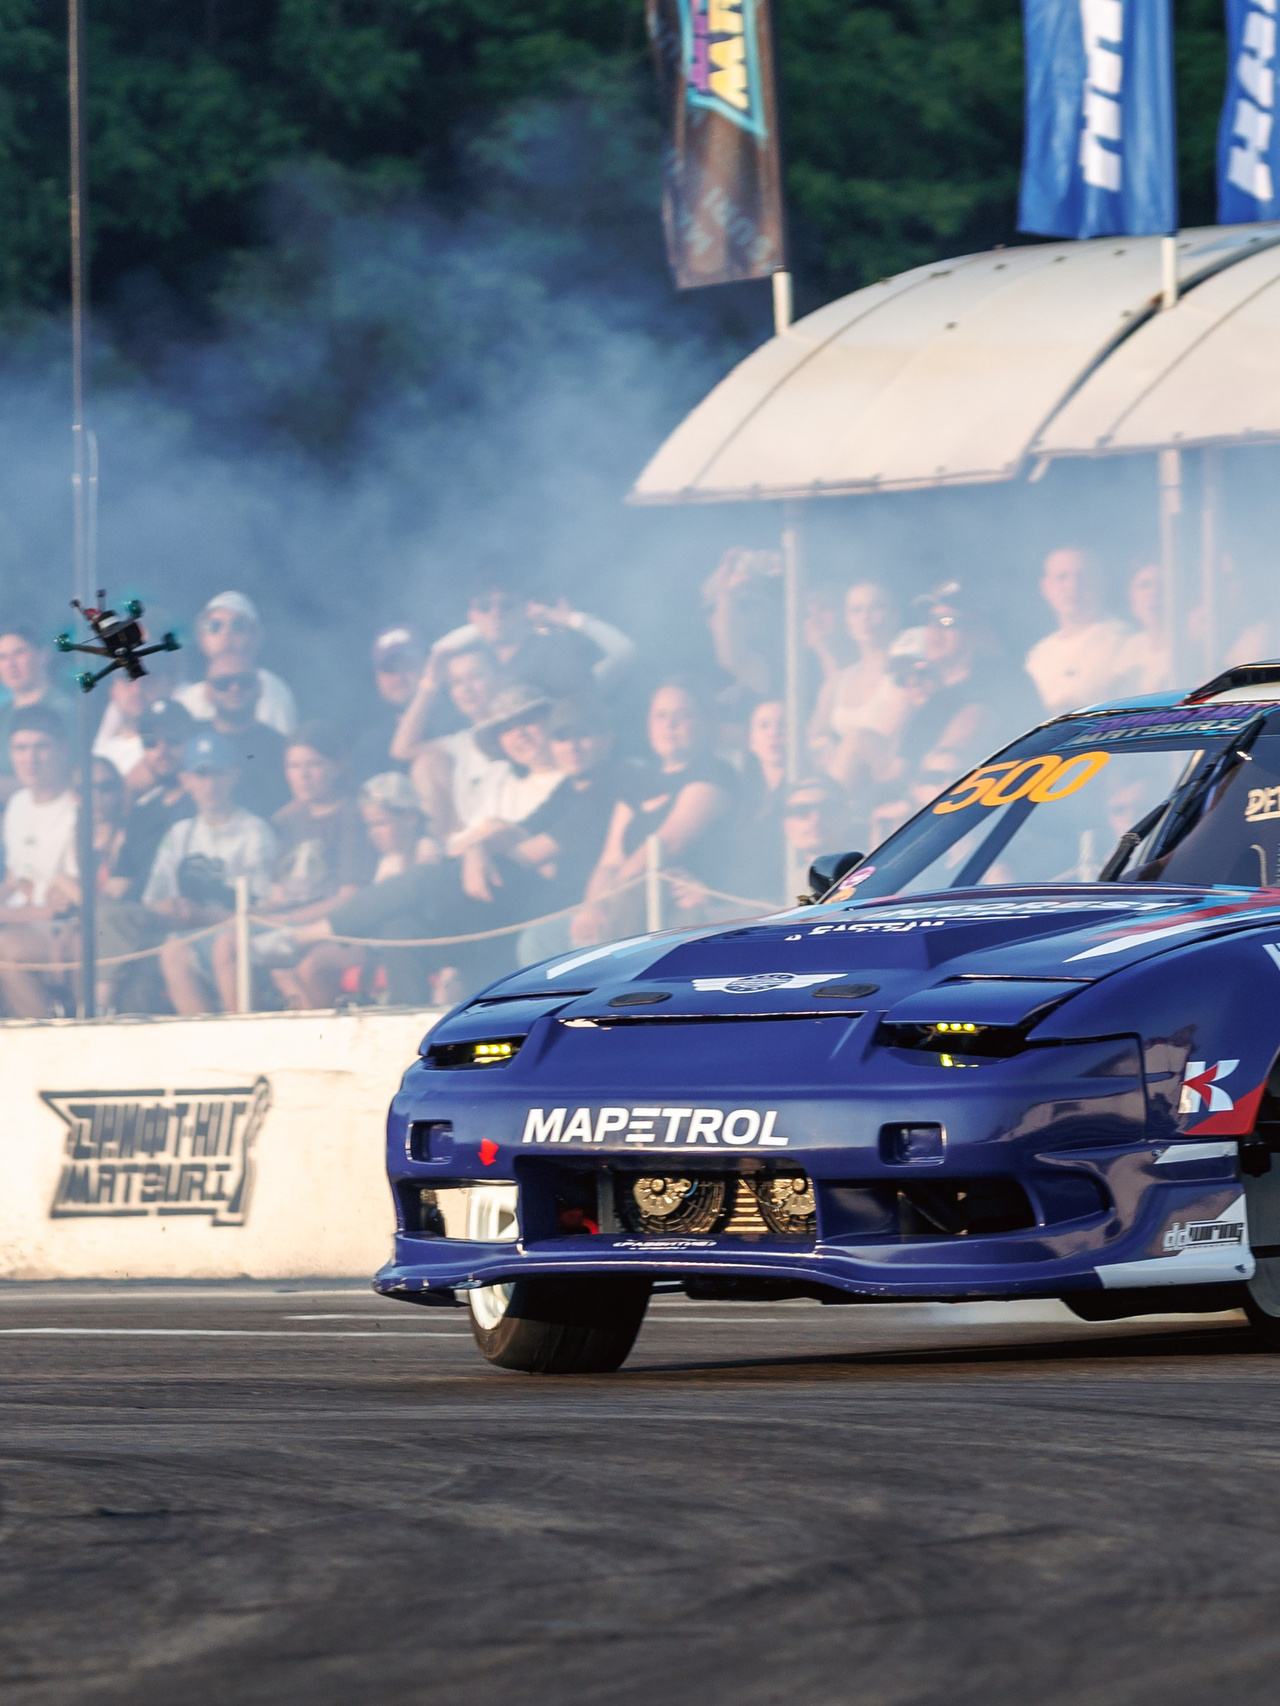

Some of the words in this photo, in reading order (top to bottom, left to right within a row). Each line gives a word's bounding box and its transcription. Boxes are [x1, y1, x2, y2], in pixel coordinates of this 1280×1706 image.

[1066, 717, 1243, 747] MATSURI
[932, 751, 1111, 815] 500
[521, 1107, 789, 1147] MAPETROL
[60, 1162, 236, 1204] MATSURI
